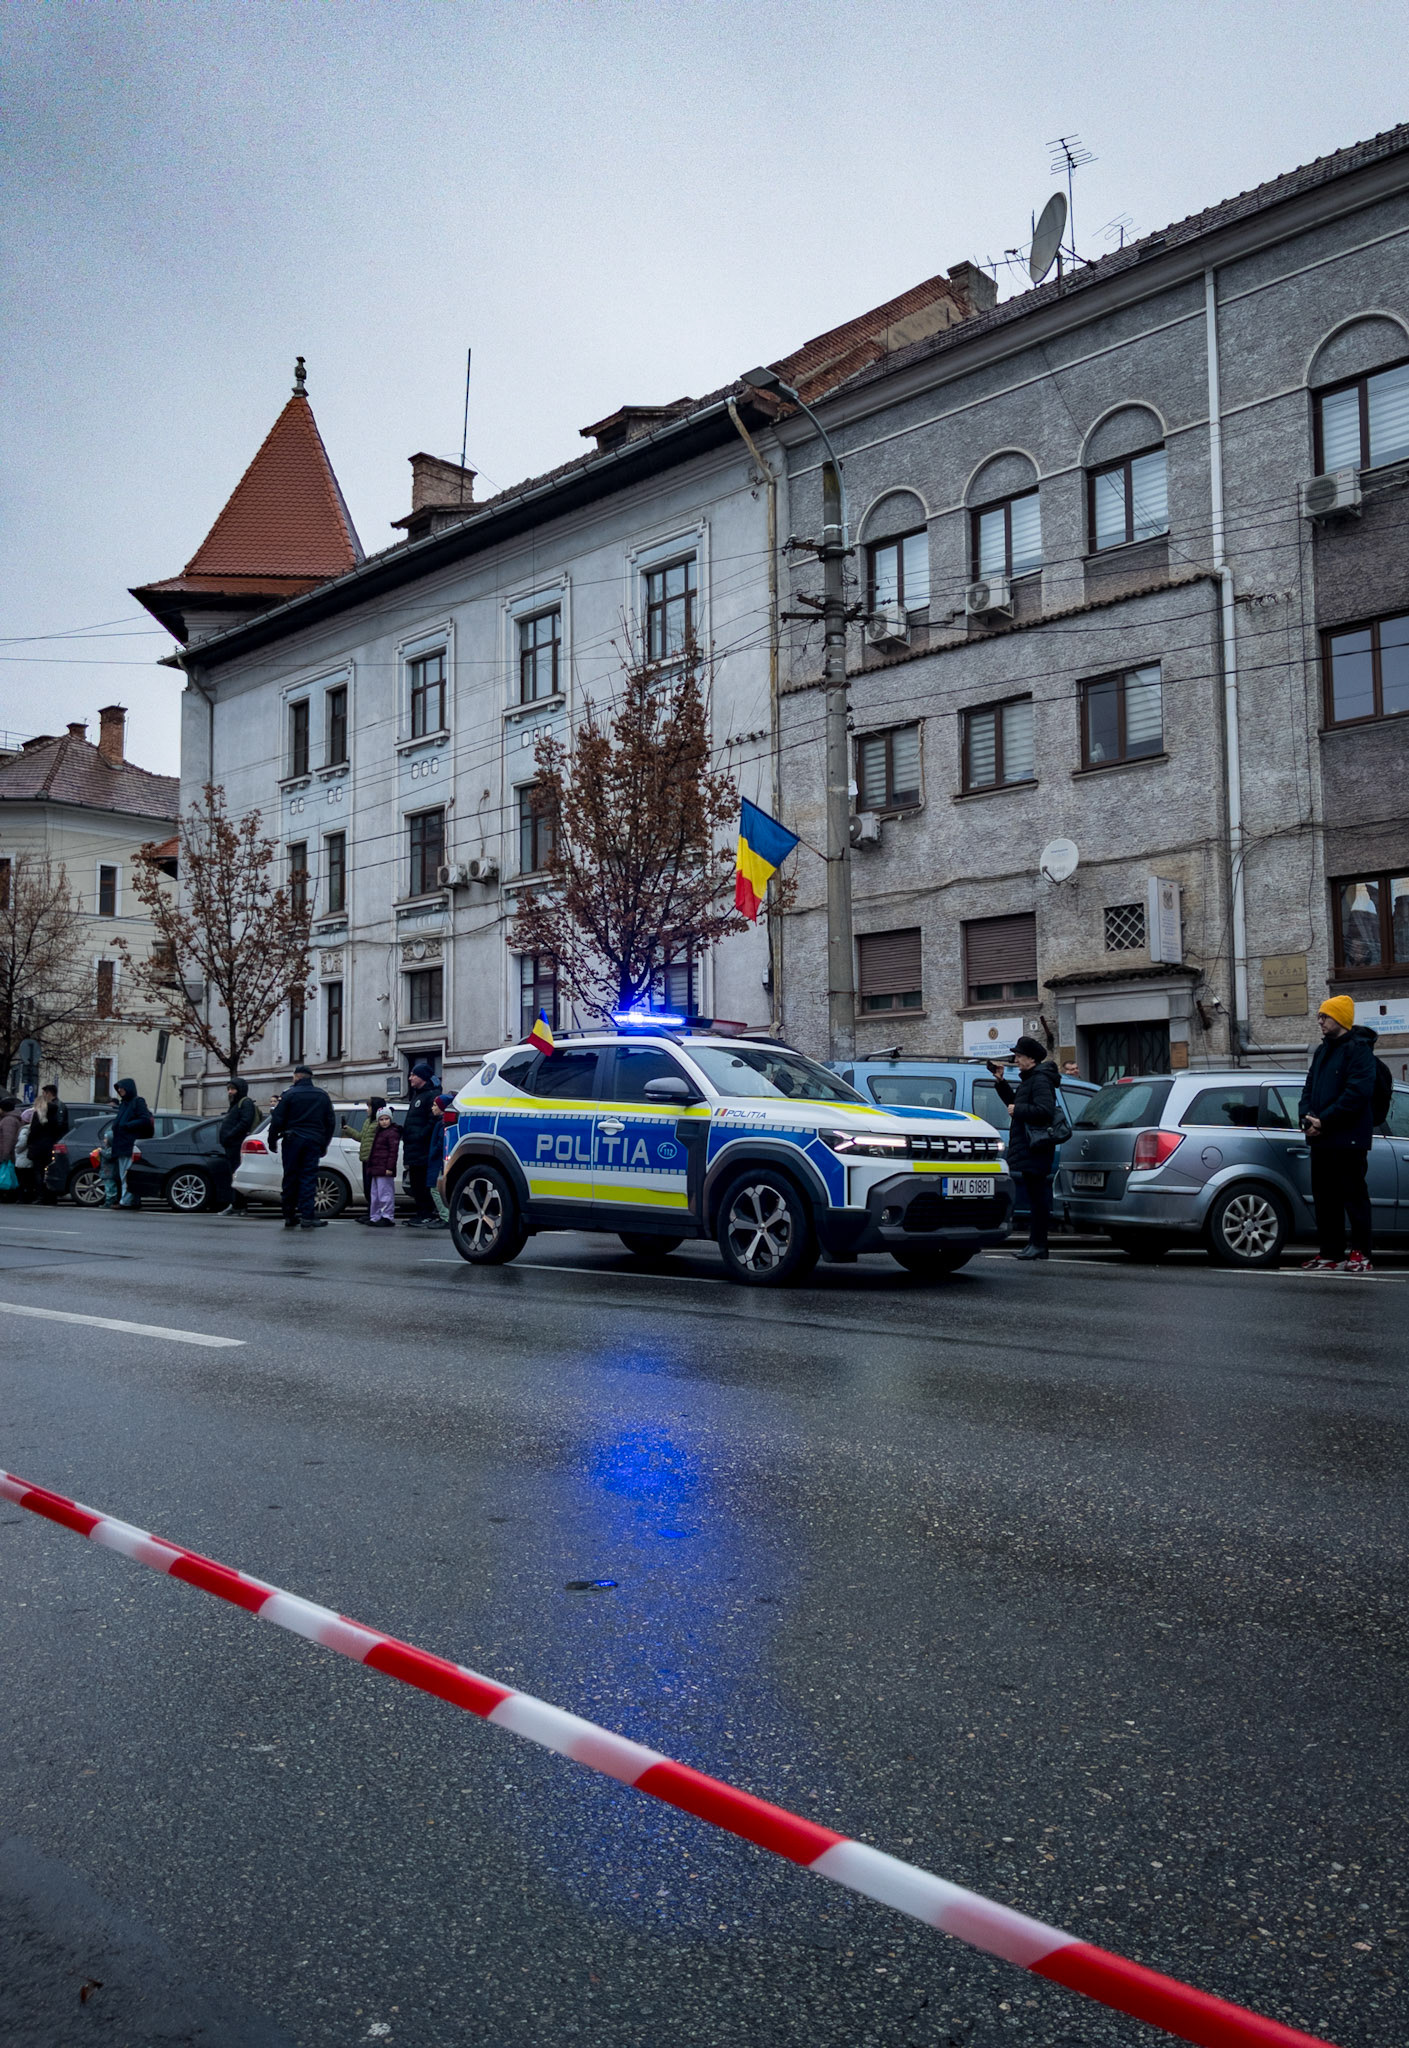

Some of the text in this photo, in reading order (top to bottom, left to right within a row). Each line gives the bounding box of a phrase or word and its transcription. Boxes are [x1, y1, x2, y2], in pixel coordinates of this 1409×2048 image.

[1267, 967, 1303, 976] AVOCAT
[726, 1109, 767, 1119] POLITIA
[535, 1133, 650, 1166] POLITIA
[663, 1148, 674, 1158] 112
[952, 1179, 991, 1194] MAI 61881
